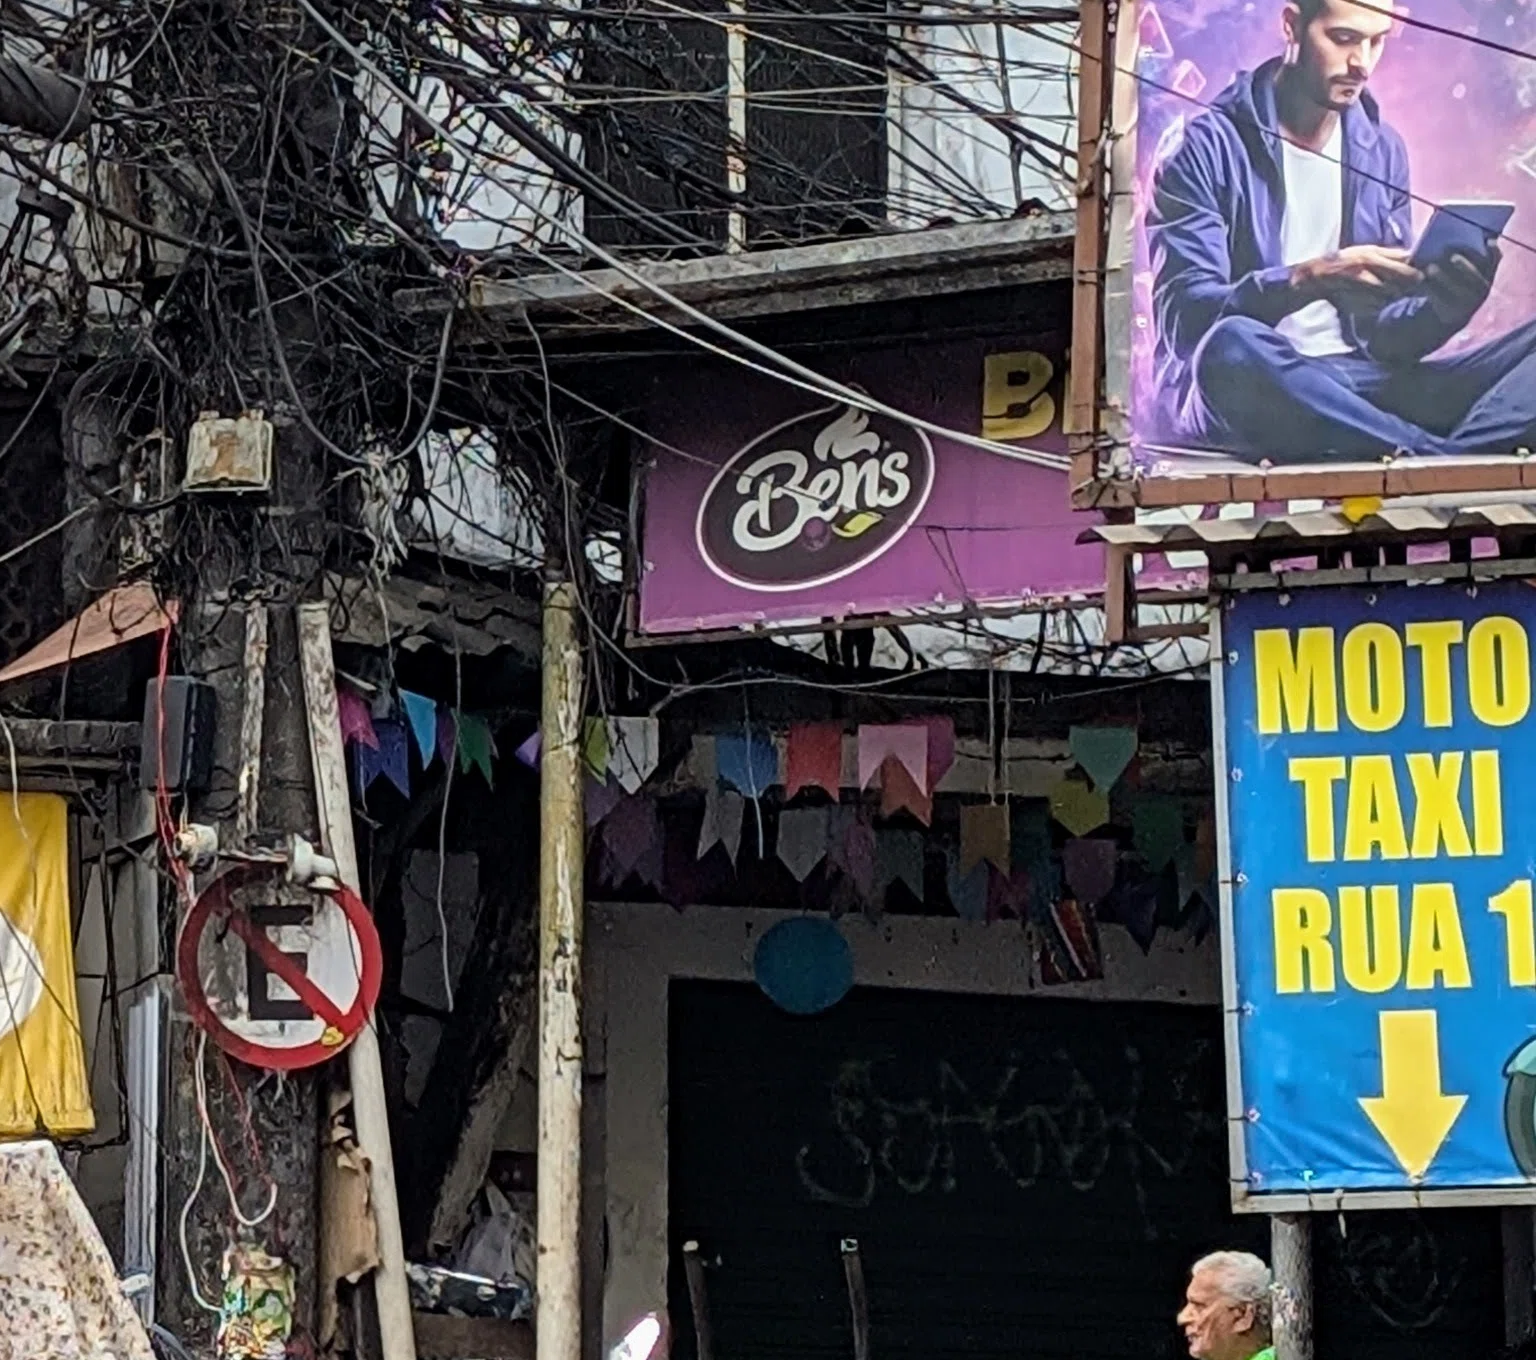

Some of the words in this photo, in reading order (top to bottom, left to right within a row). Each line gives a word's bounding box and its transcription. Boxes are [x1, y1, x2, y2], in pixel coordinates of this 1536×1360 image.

[732, 449, 911, 552] Bens
[1252, 615, 1532, 735] MOTO
[1288, 749, 1504, 863] TAXI
[1270, 882, 1473, 995] RUA
[1487, 878, 1536, 988] 1
